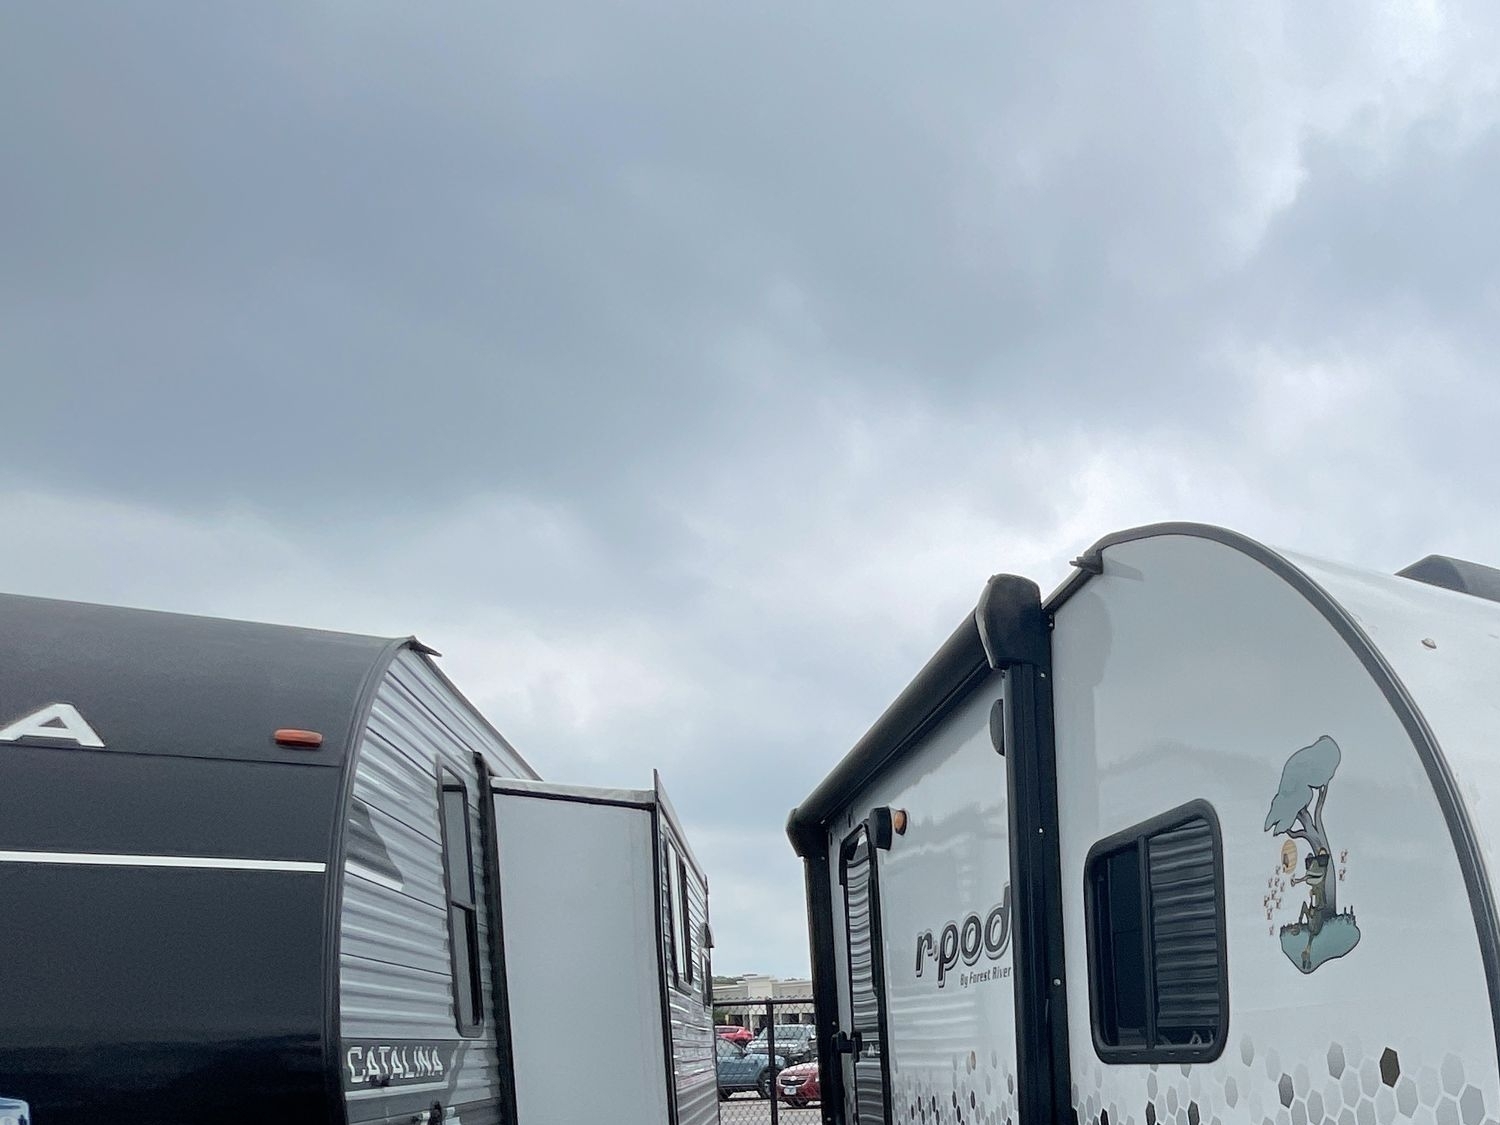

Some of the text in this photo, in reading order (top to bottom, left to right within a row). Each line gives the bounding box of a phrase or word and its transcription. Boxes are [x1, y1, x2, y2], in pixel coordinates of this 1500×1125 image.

[969, 968, 991, 984] Forest
[992, 966, 1012, 979] River
[346, 1046, 444, 1083] CATALINA
